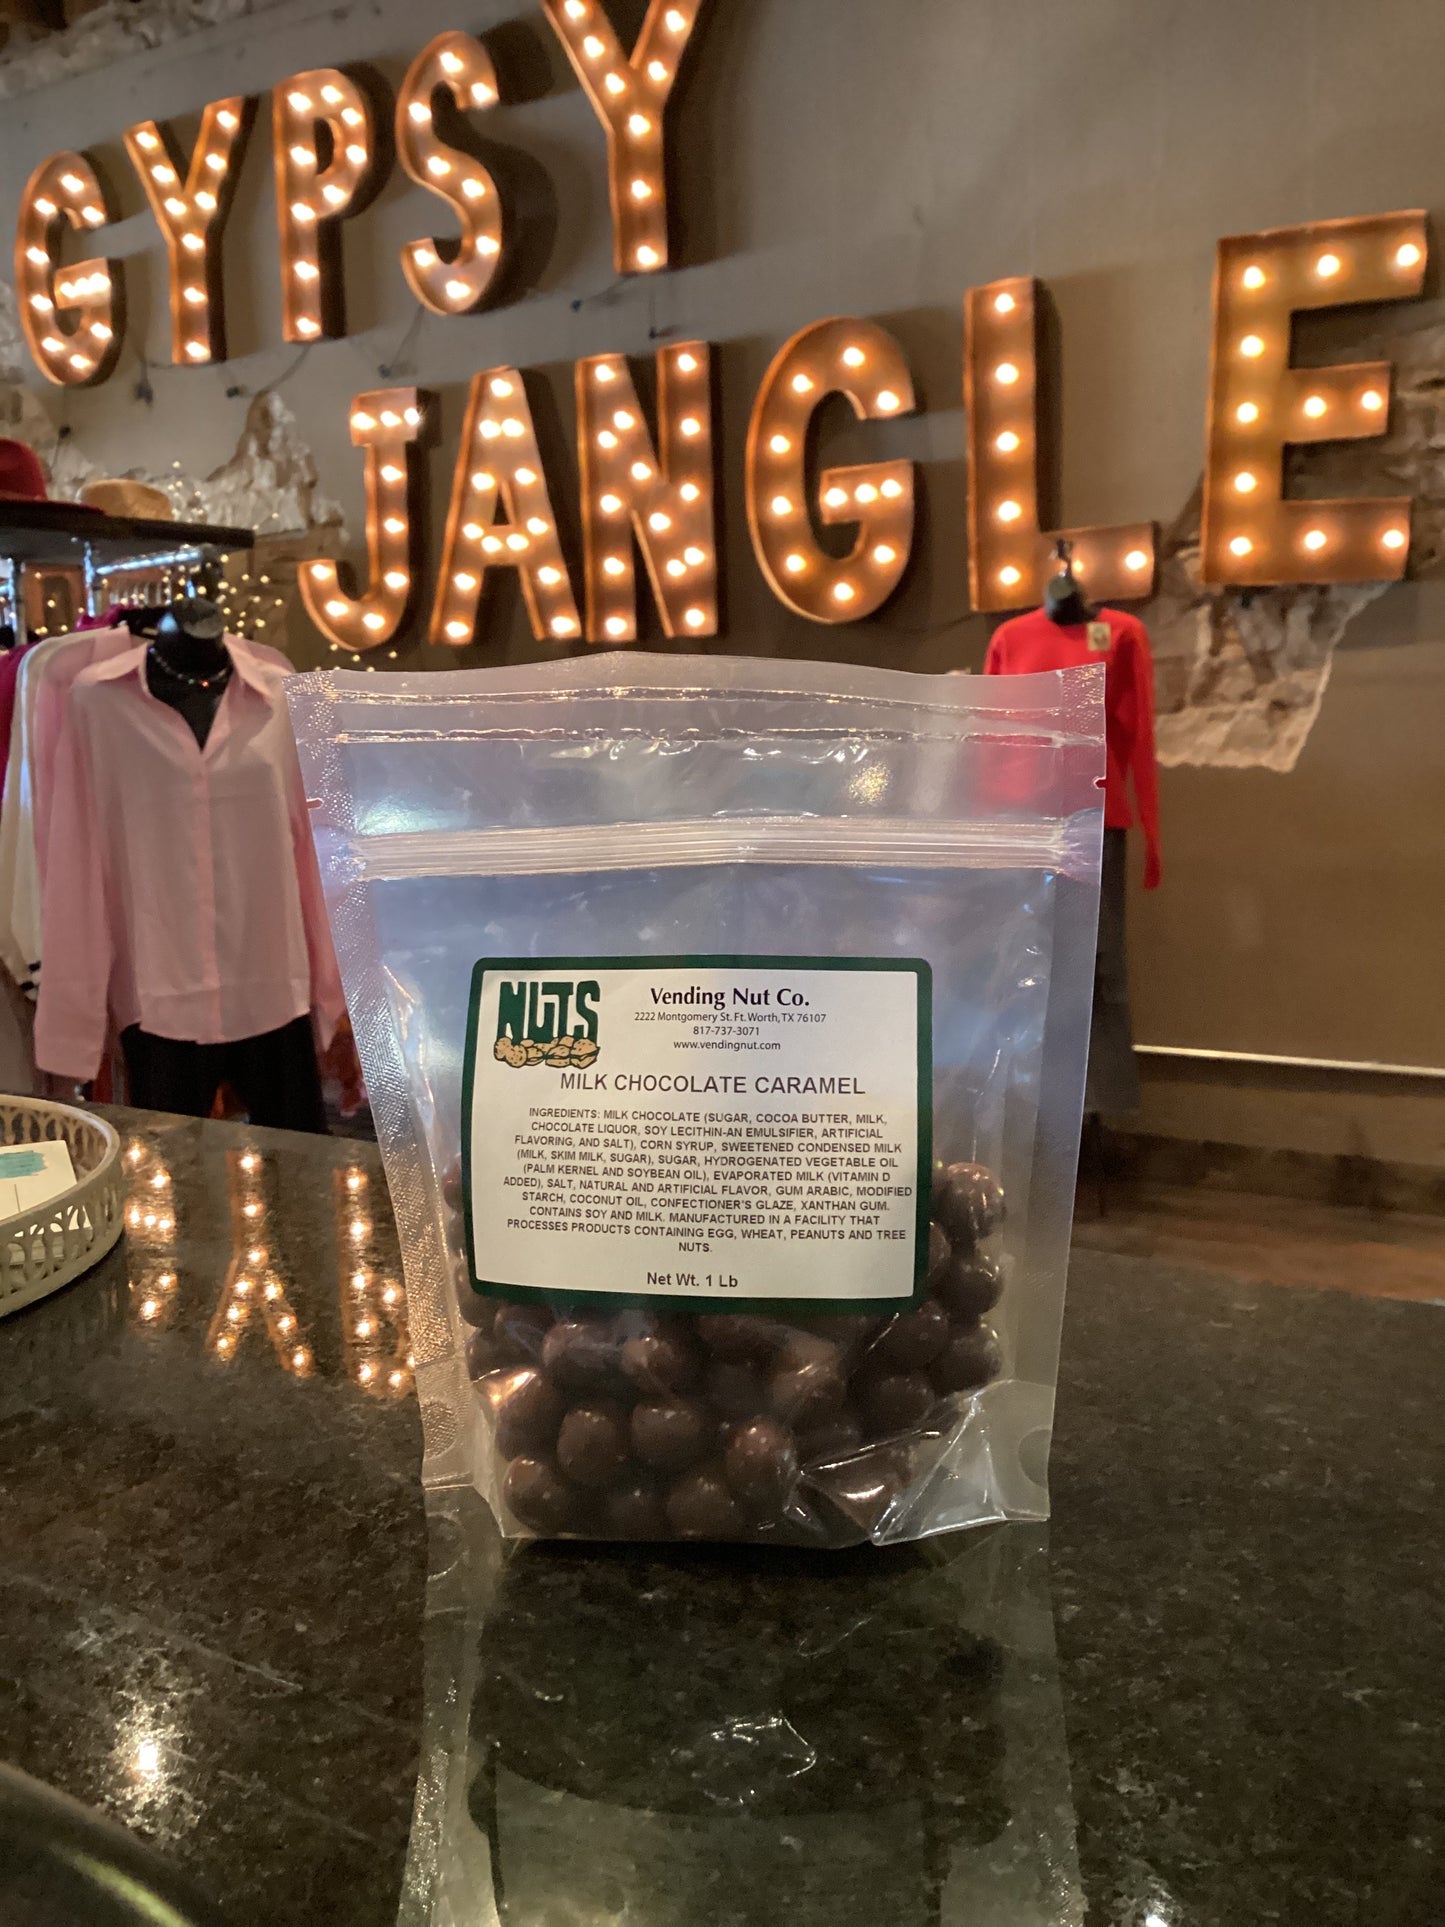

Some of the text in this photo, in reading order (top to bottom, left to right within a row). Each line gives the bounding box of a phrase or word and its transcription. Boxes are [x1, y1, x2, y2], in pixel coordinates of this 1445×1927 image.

[14, 0, 700, 386] GYPSY
[300, 208, 1429, 651] JANGLE
[650, 986, 810, 1010] Vending Nut Co.
[497, 980, 600, 1045] NUTS
[635, 1012, 655, 1021] 2222
[658, 1012, 717, 1023] Montgomery
[720, 1012, 732, 1022] St.
[734, 1013, 747, 1022] Ft.
[797, 1014, 826, 1023] 76107
[693, 1026, 759, 1036] 817-737-3071
[673, 1040, 780, 1051] www.vendingnut.com
[561, 1073, 865, 1095] MILK CHOCOLATE CARAMEL
[529, 1108, 887, 1125] INGREDIENTS: MILK CHOCOLATE (SUGAR, COCOA BUTTER, MILK,
[531, 1122, 883, 1139] CHOCOLATE LIQUOR, SOY LECITHIN-AN EMULSIFIER, ARTIFICIAL
[515, 1135, 902, 1153] FLAVORING, AND SALT), CORN SYRUP, SWEETENED CONDENSED MILK
[517, 1150, 899, 1167] (MILK, SKIM MILK, SUGAR), SUGAR, HYDROGENATED VEGETABLE OIL
[524, 1164, 890, 1182] (PALM KERNEL AND SOYBEAN OIL), EVAPORATED MILK (VITAMIN D
[504, 1177, 912, 1197] ADDED), SALT, NATURAL AND ARTIFICIAL FLAVOR, GUM ARABIC, MODIFIED
[523, 1192, 890, 1211] STARCH, COCONUT OIL, CONFECTIONER'S GLAZE, XANTHAN GUM.
[530, 1206, 880, 1225] CONTAINS SOY AND MILK. MANUFACTURED IN A FACILITY THAT
[507, 1219, 906, 1240] PROCESSES PRODUCTS CONTAINING EGG, WHEAT, PEANUTS AND TREE
[679, 1242, 712, 1252] NUTS.
[647, 1272, 738, 1287] Net Wt. 1 Lb
